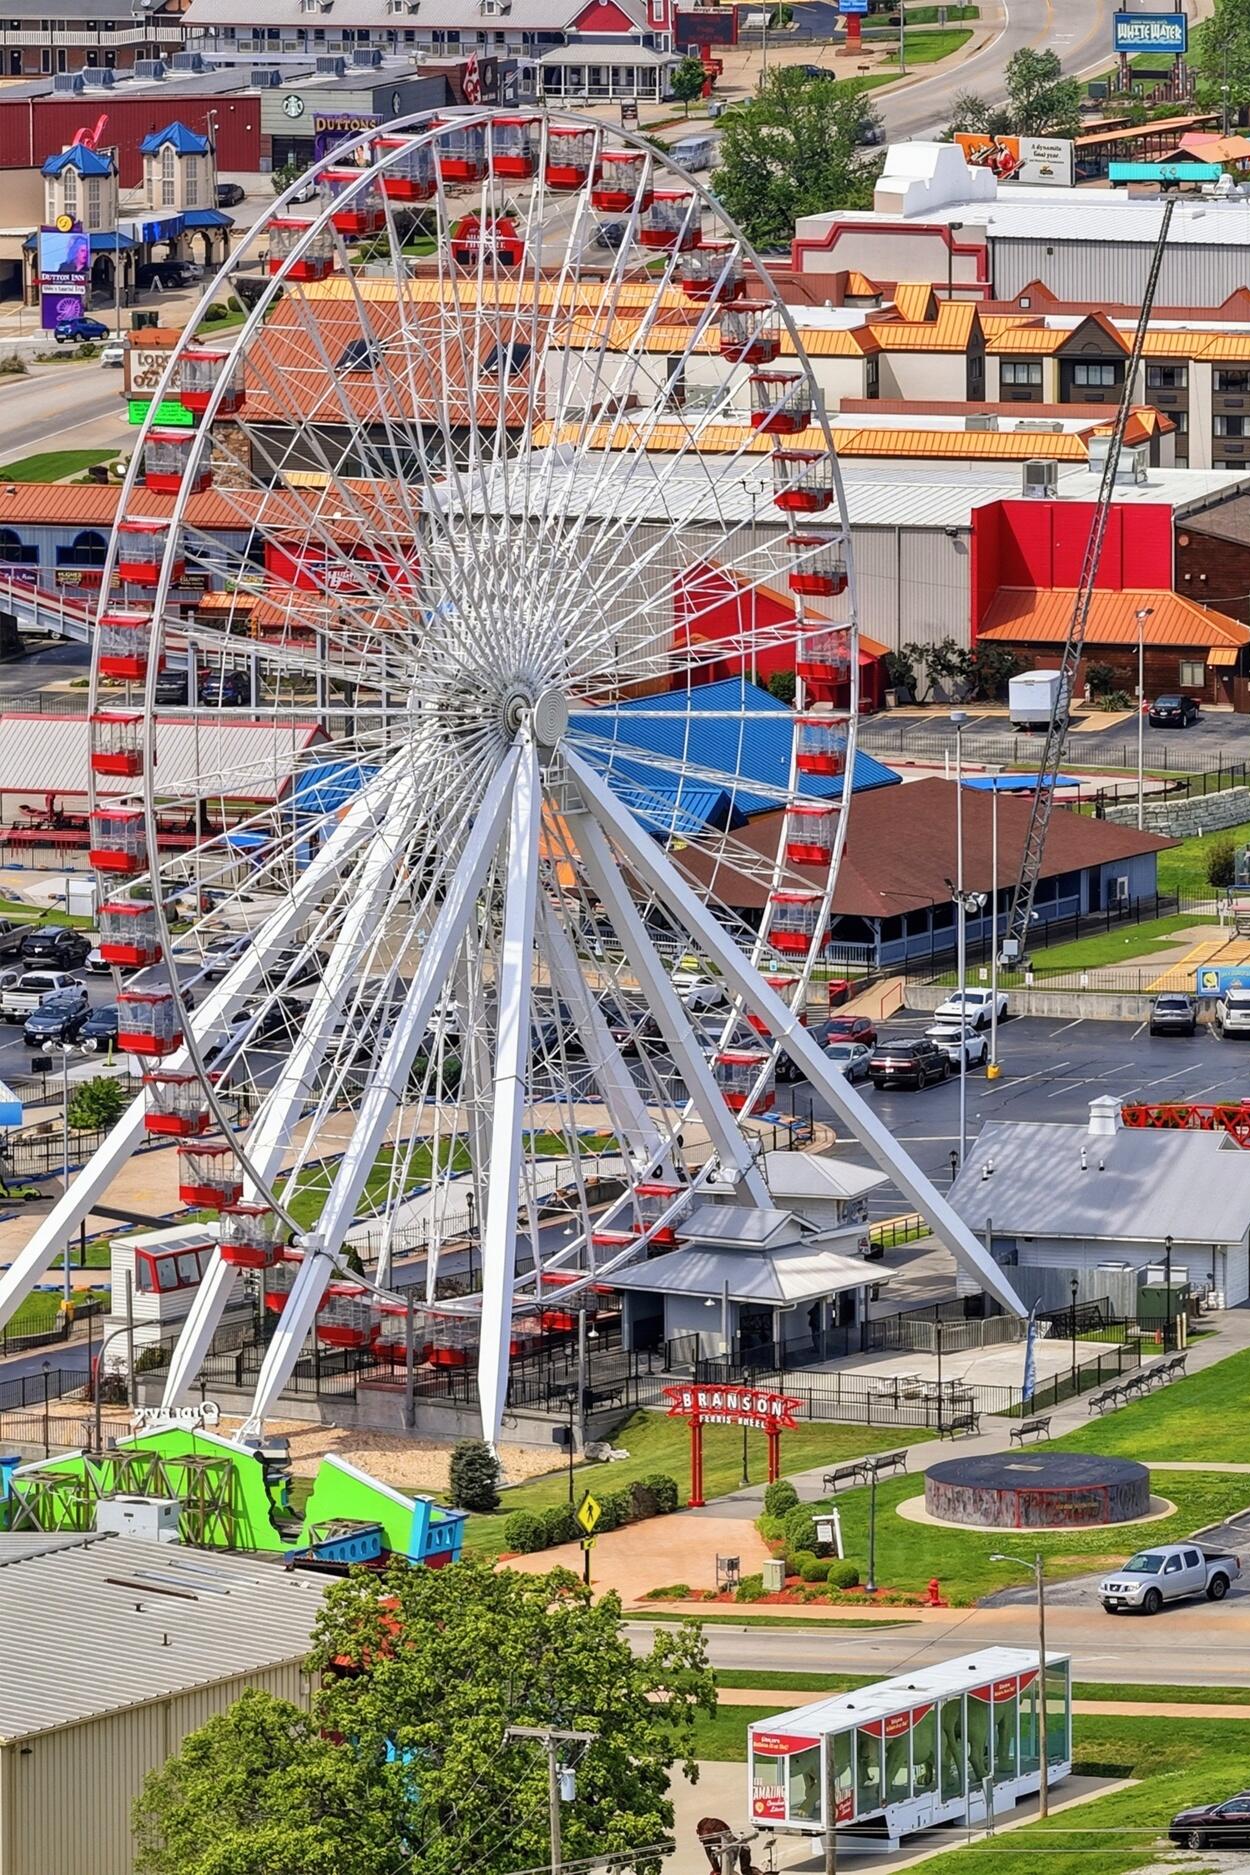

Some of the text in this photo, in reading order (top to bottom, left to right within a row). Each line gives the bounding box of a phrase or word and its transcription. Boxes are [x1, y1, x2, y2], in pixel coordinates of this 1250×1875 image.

[316, 117, 378, 132] DUTTONS
[41, 273, 70, 281] DUTTON
[682, 1392, 782, 1417] BRANSON
